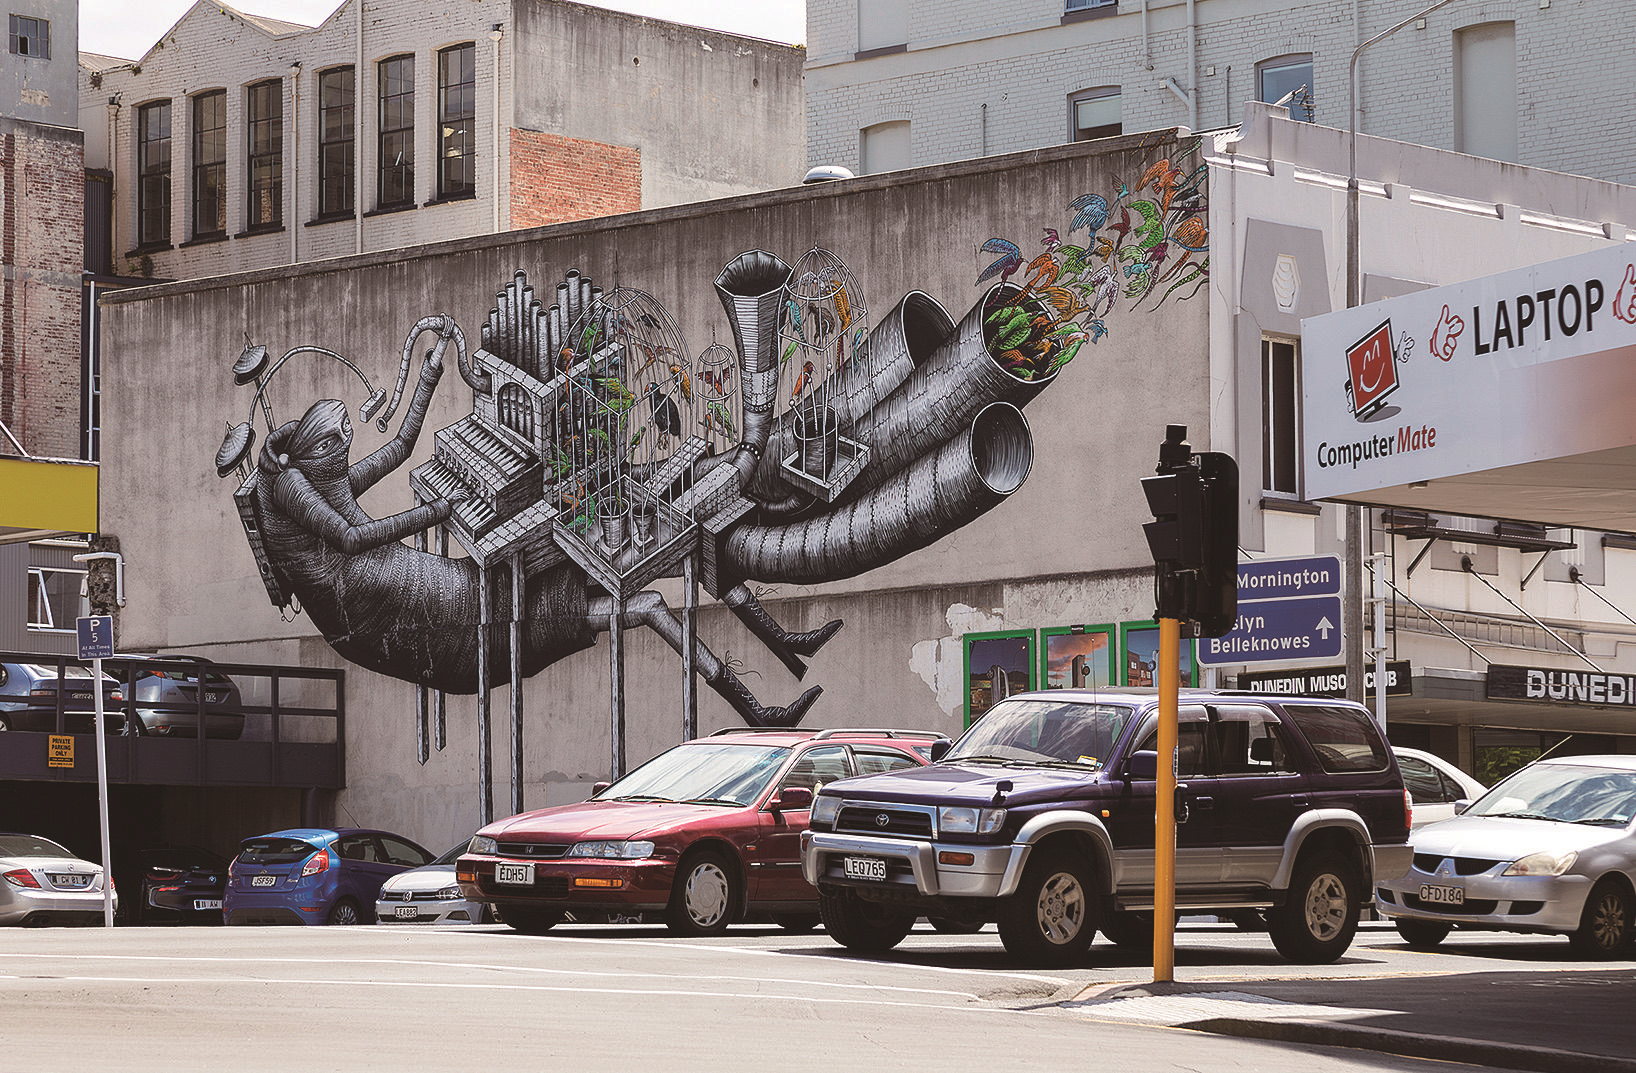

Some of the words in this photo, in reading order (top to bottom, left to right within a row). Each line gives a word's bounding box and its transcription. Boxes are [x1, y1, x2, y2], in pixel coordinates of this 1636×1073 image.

[1473, 279, 1604, 356] LAPTOP
[1317, 434, 1395, 469] Computer
[1397, 424, 1437, 454] Mate
[1237, 569, 1329, 590] Mornington
[91, 619, 101, 632] P
[1231, 615, 1265, 633] slyn
[92, 633, 98, 643] 5
[1210, 635, 1311, 654] Belleknowes
[1250, 677, 1305, 694] DUNEDIN
[1527, 669, 1636, 705] DUNEDI
[500, 867, 528, 881] EDH51
[845, 860, 885, 876] LEQ765
[1420, 886, 1462, 902] CFD184
